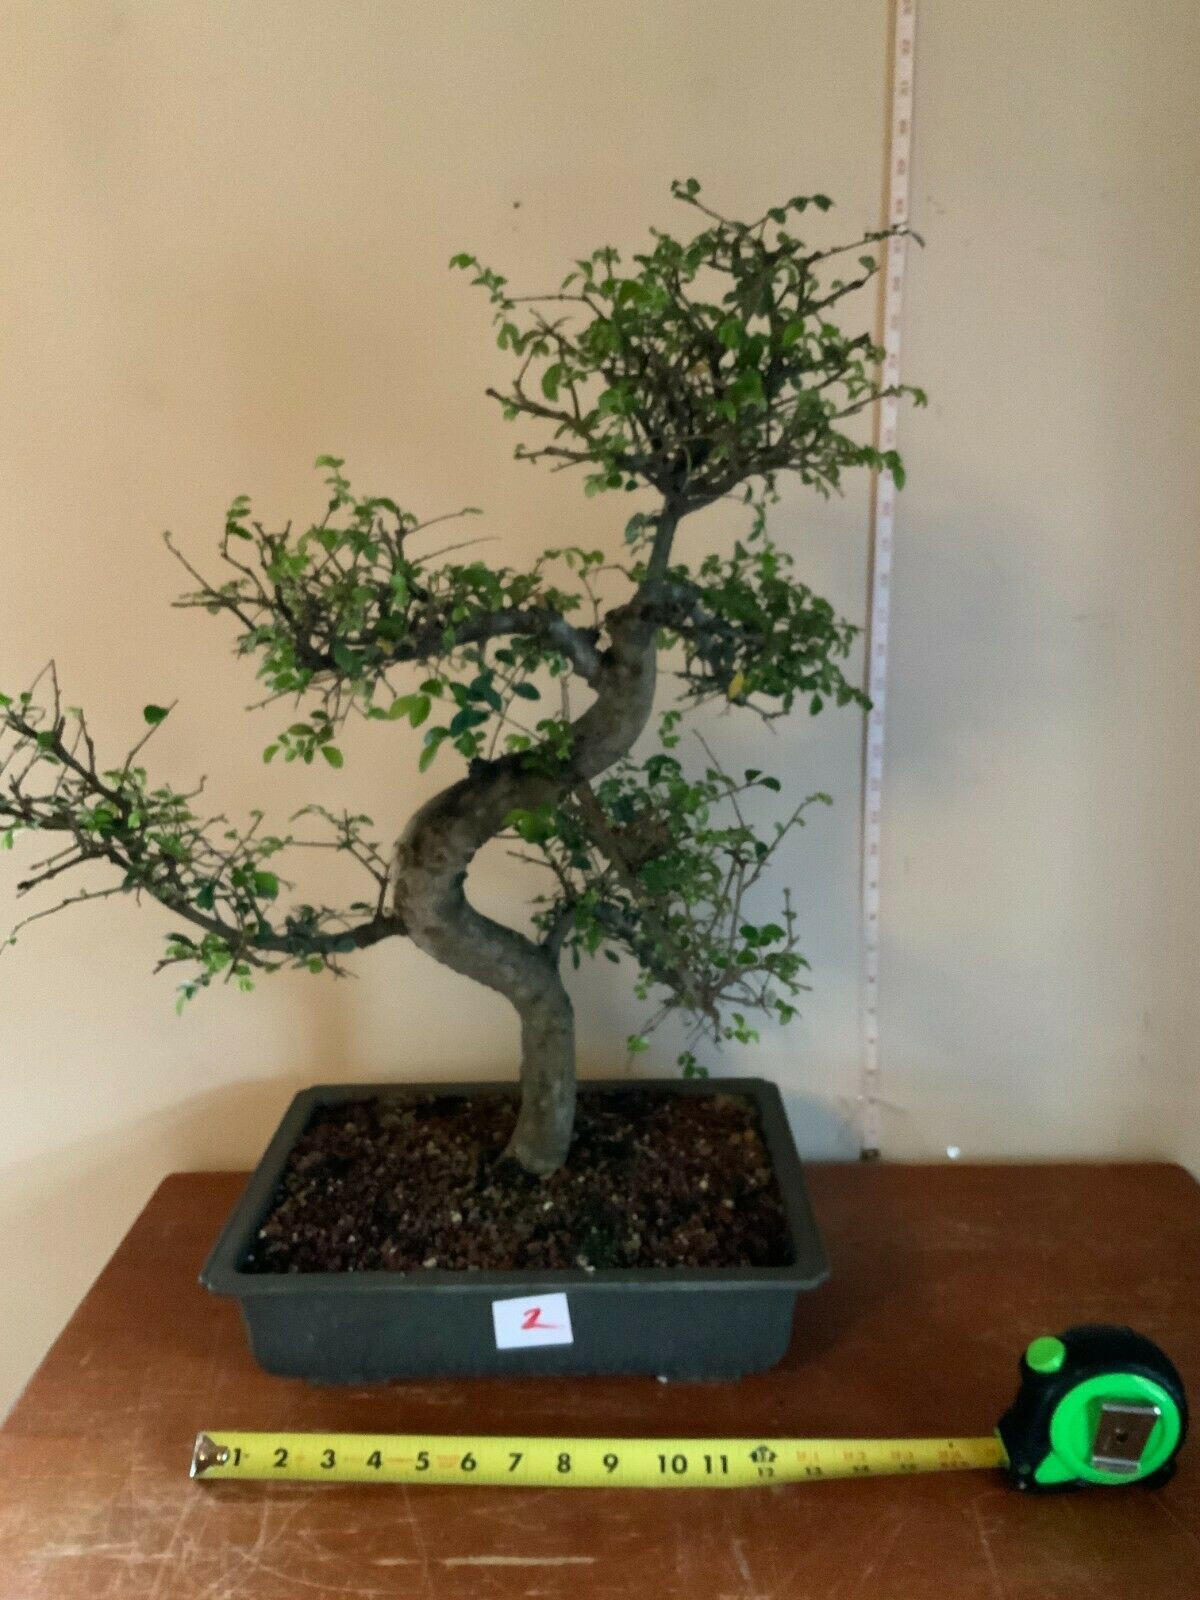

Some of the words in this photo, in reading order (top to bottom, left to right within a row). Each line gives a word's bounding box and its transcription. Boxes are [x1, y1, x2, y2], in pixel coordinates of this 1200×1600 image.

[520, 1307, 561, 1330] 2
[232, 1448, 242, 1466] 1
[273, 1449, 289, 1468] 2
[320, 1450, 337, 1469] 3
[366, 1451, 382, 1470] 4
[415, 1452, 430, 1471] 5
[460, 1453, 477, 1472] 6
[508, 1453, 523, 1472] 7
[556, 1454, 572, 1473] 8
[602, 1454, 619, 1473] 9
[657, 1455, 688, 1474] 10
[703, 1455, 729, 1475] 11
